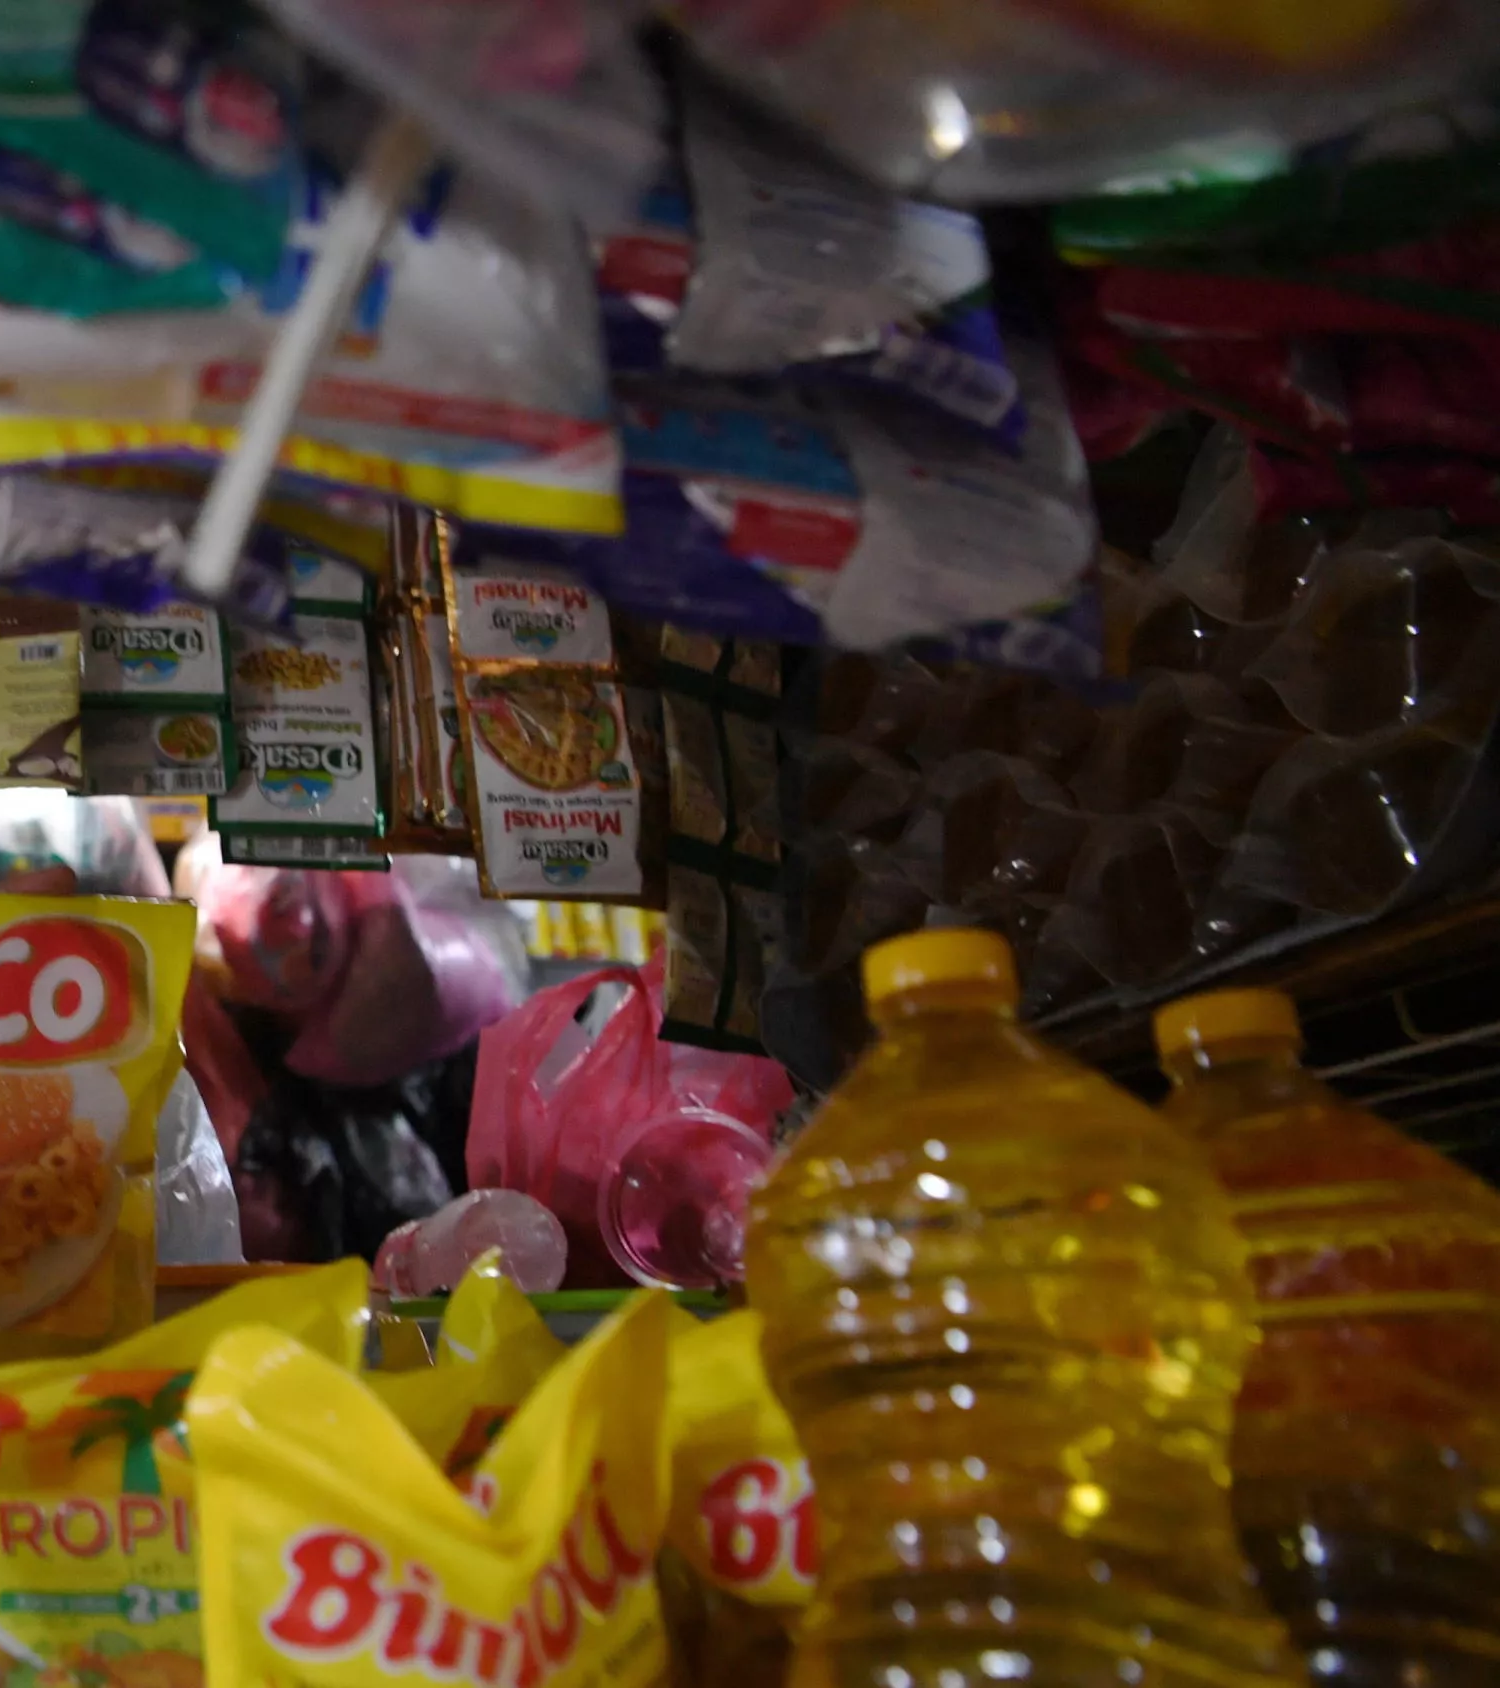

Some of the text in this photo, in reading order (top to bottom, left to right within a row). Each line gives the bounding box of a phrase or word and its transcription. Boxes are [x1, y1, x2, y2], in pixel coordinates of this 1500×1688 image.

[92, 628, 204, 658] Desaku
[503, 809, 622, 837] Marinasi
[521, 840, 609, 866] Desaku
